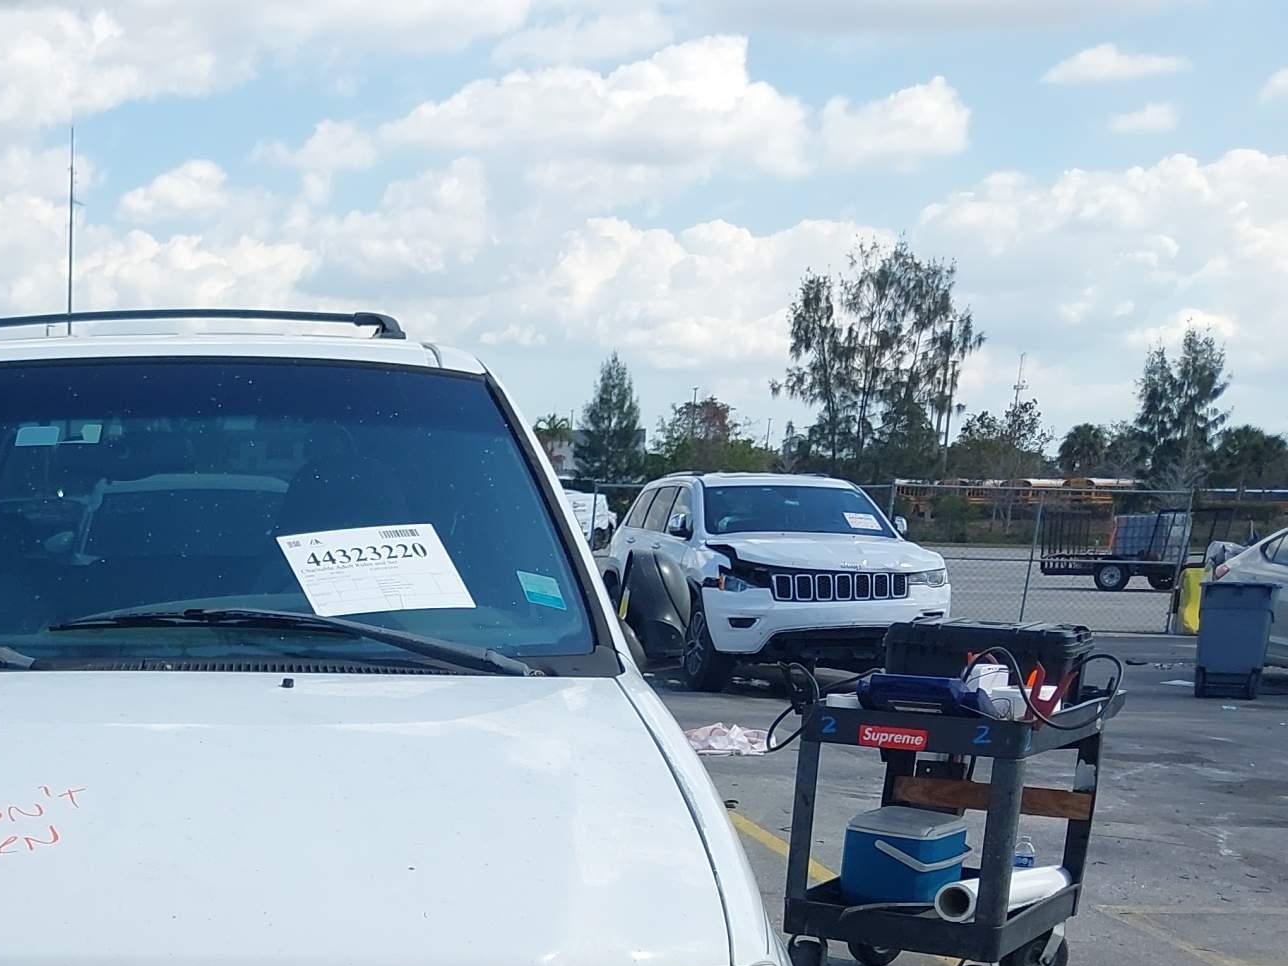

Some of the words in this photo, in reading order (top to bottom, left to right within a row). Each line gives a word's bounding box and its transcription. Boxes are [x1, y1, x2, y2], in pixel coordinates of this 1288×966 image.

[307, 543, 428, 567] 44323220
[821, 716, 837, 734] 2
[973, 725, 992, 744] 2
[862, 727, 924, 746] Supreme
